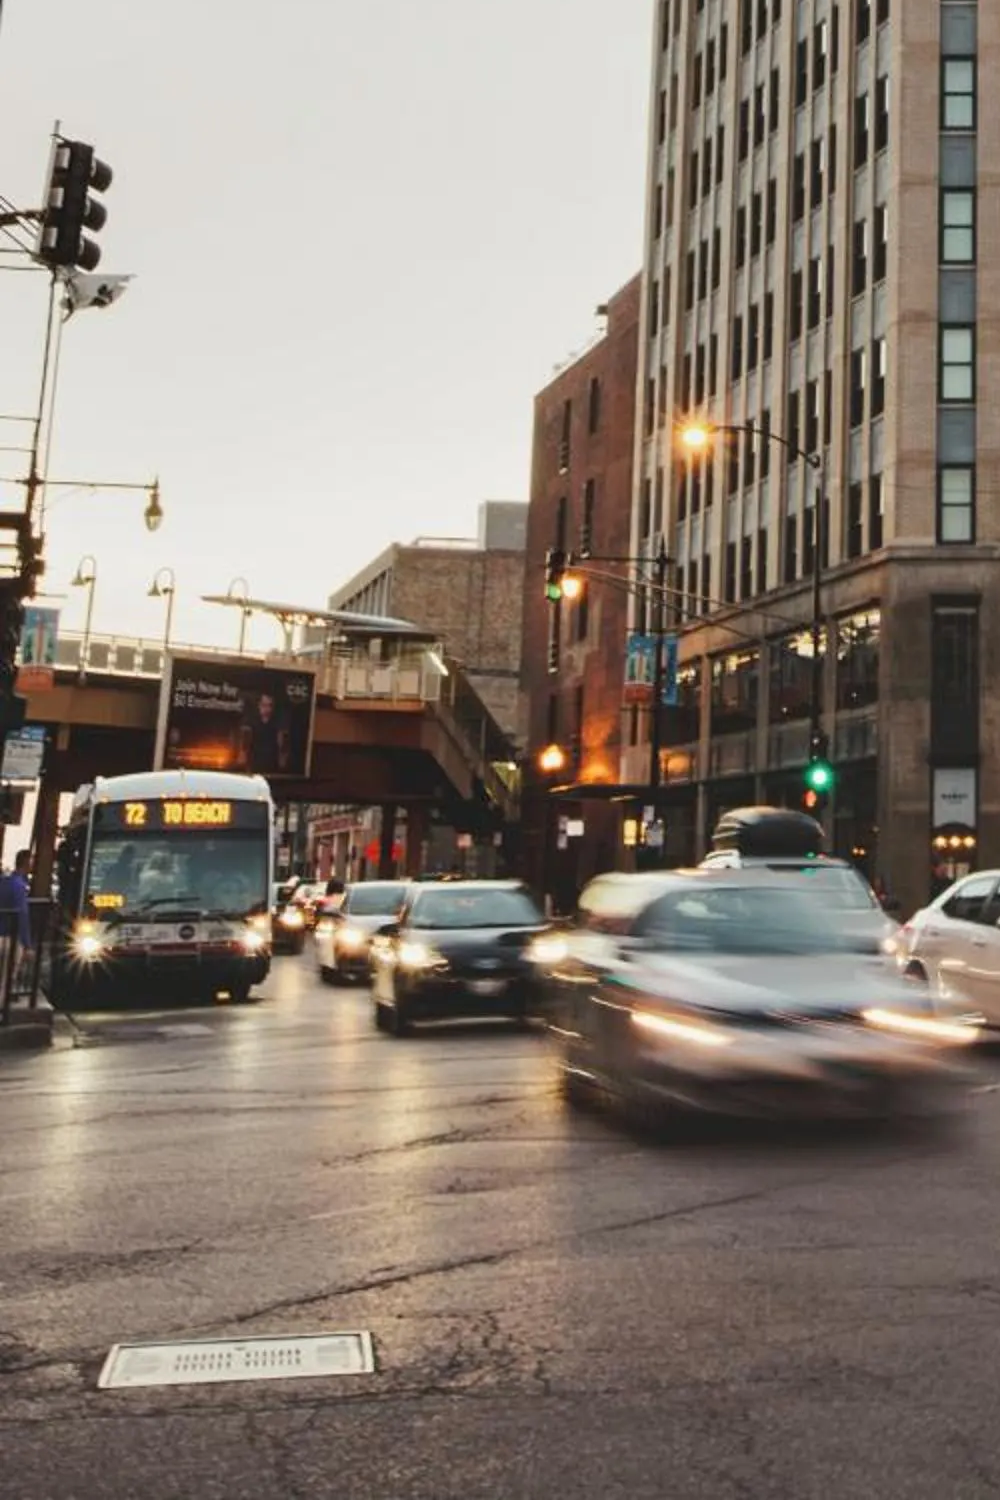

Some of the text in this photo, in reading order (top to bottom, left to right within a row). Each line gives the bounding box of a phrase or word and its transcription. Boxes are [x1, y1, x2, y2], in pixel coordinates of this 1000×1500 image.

[198, 680, 221, 694] Now
[125, 802, 231, 824] 72 TO BEACH
